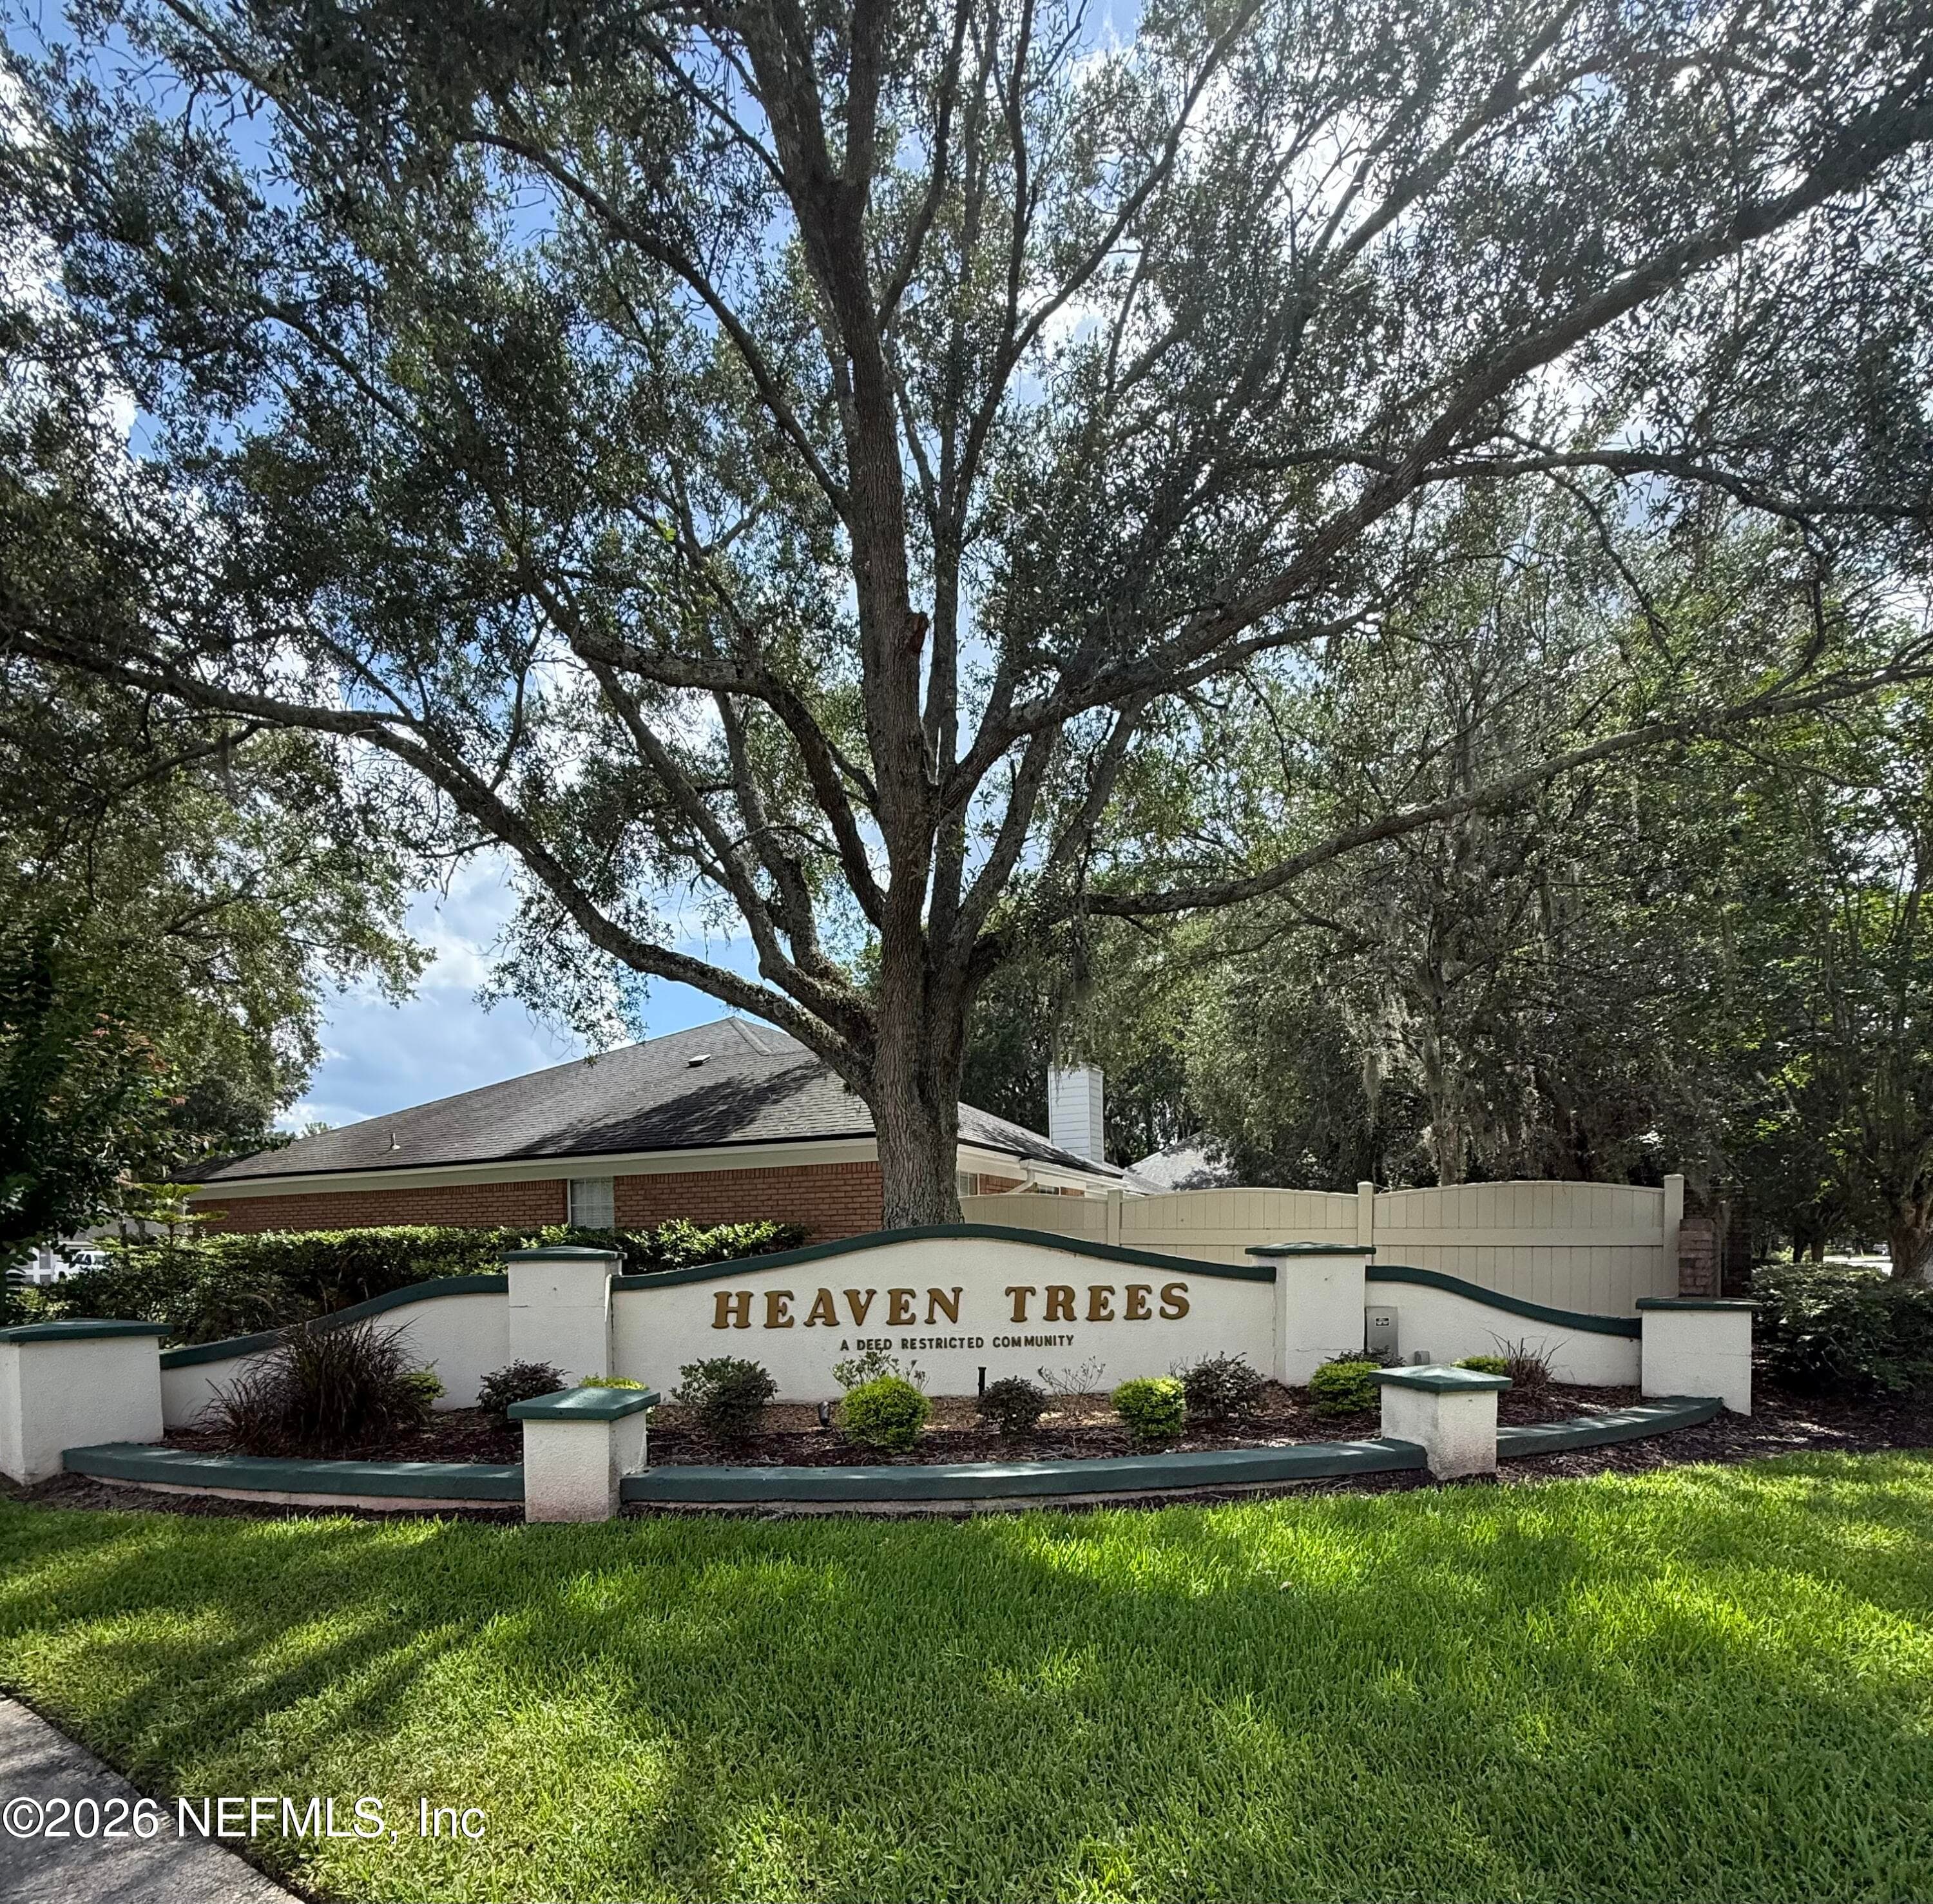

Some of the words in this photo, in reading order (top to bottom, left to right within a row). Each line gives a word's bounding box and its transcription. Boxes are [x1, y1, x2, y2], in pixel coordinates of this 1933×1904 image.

[710, 1286, 964, 1329] HEAVEN
[1005, 1282, 1191, 1323] TREES
[840, 1339, 850, 1352] A
[856, 1338, 892, 1351] DEED
[901, 1336, 985, 1351] RESTRICTED
[992, 1334, 1075, 1349] COMMUNITY
